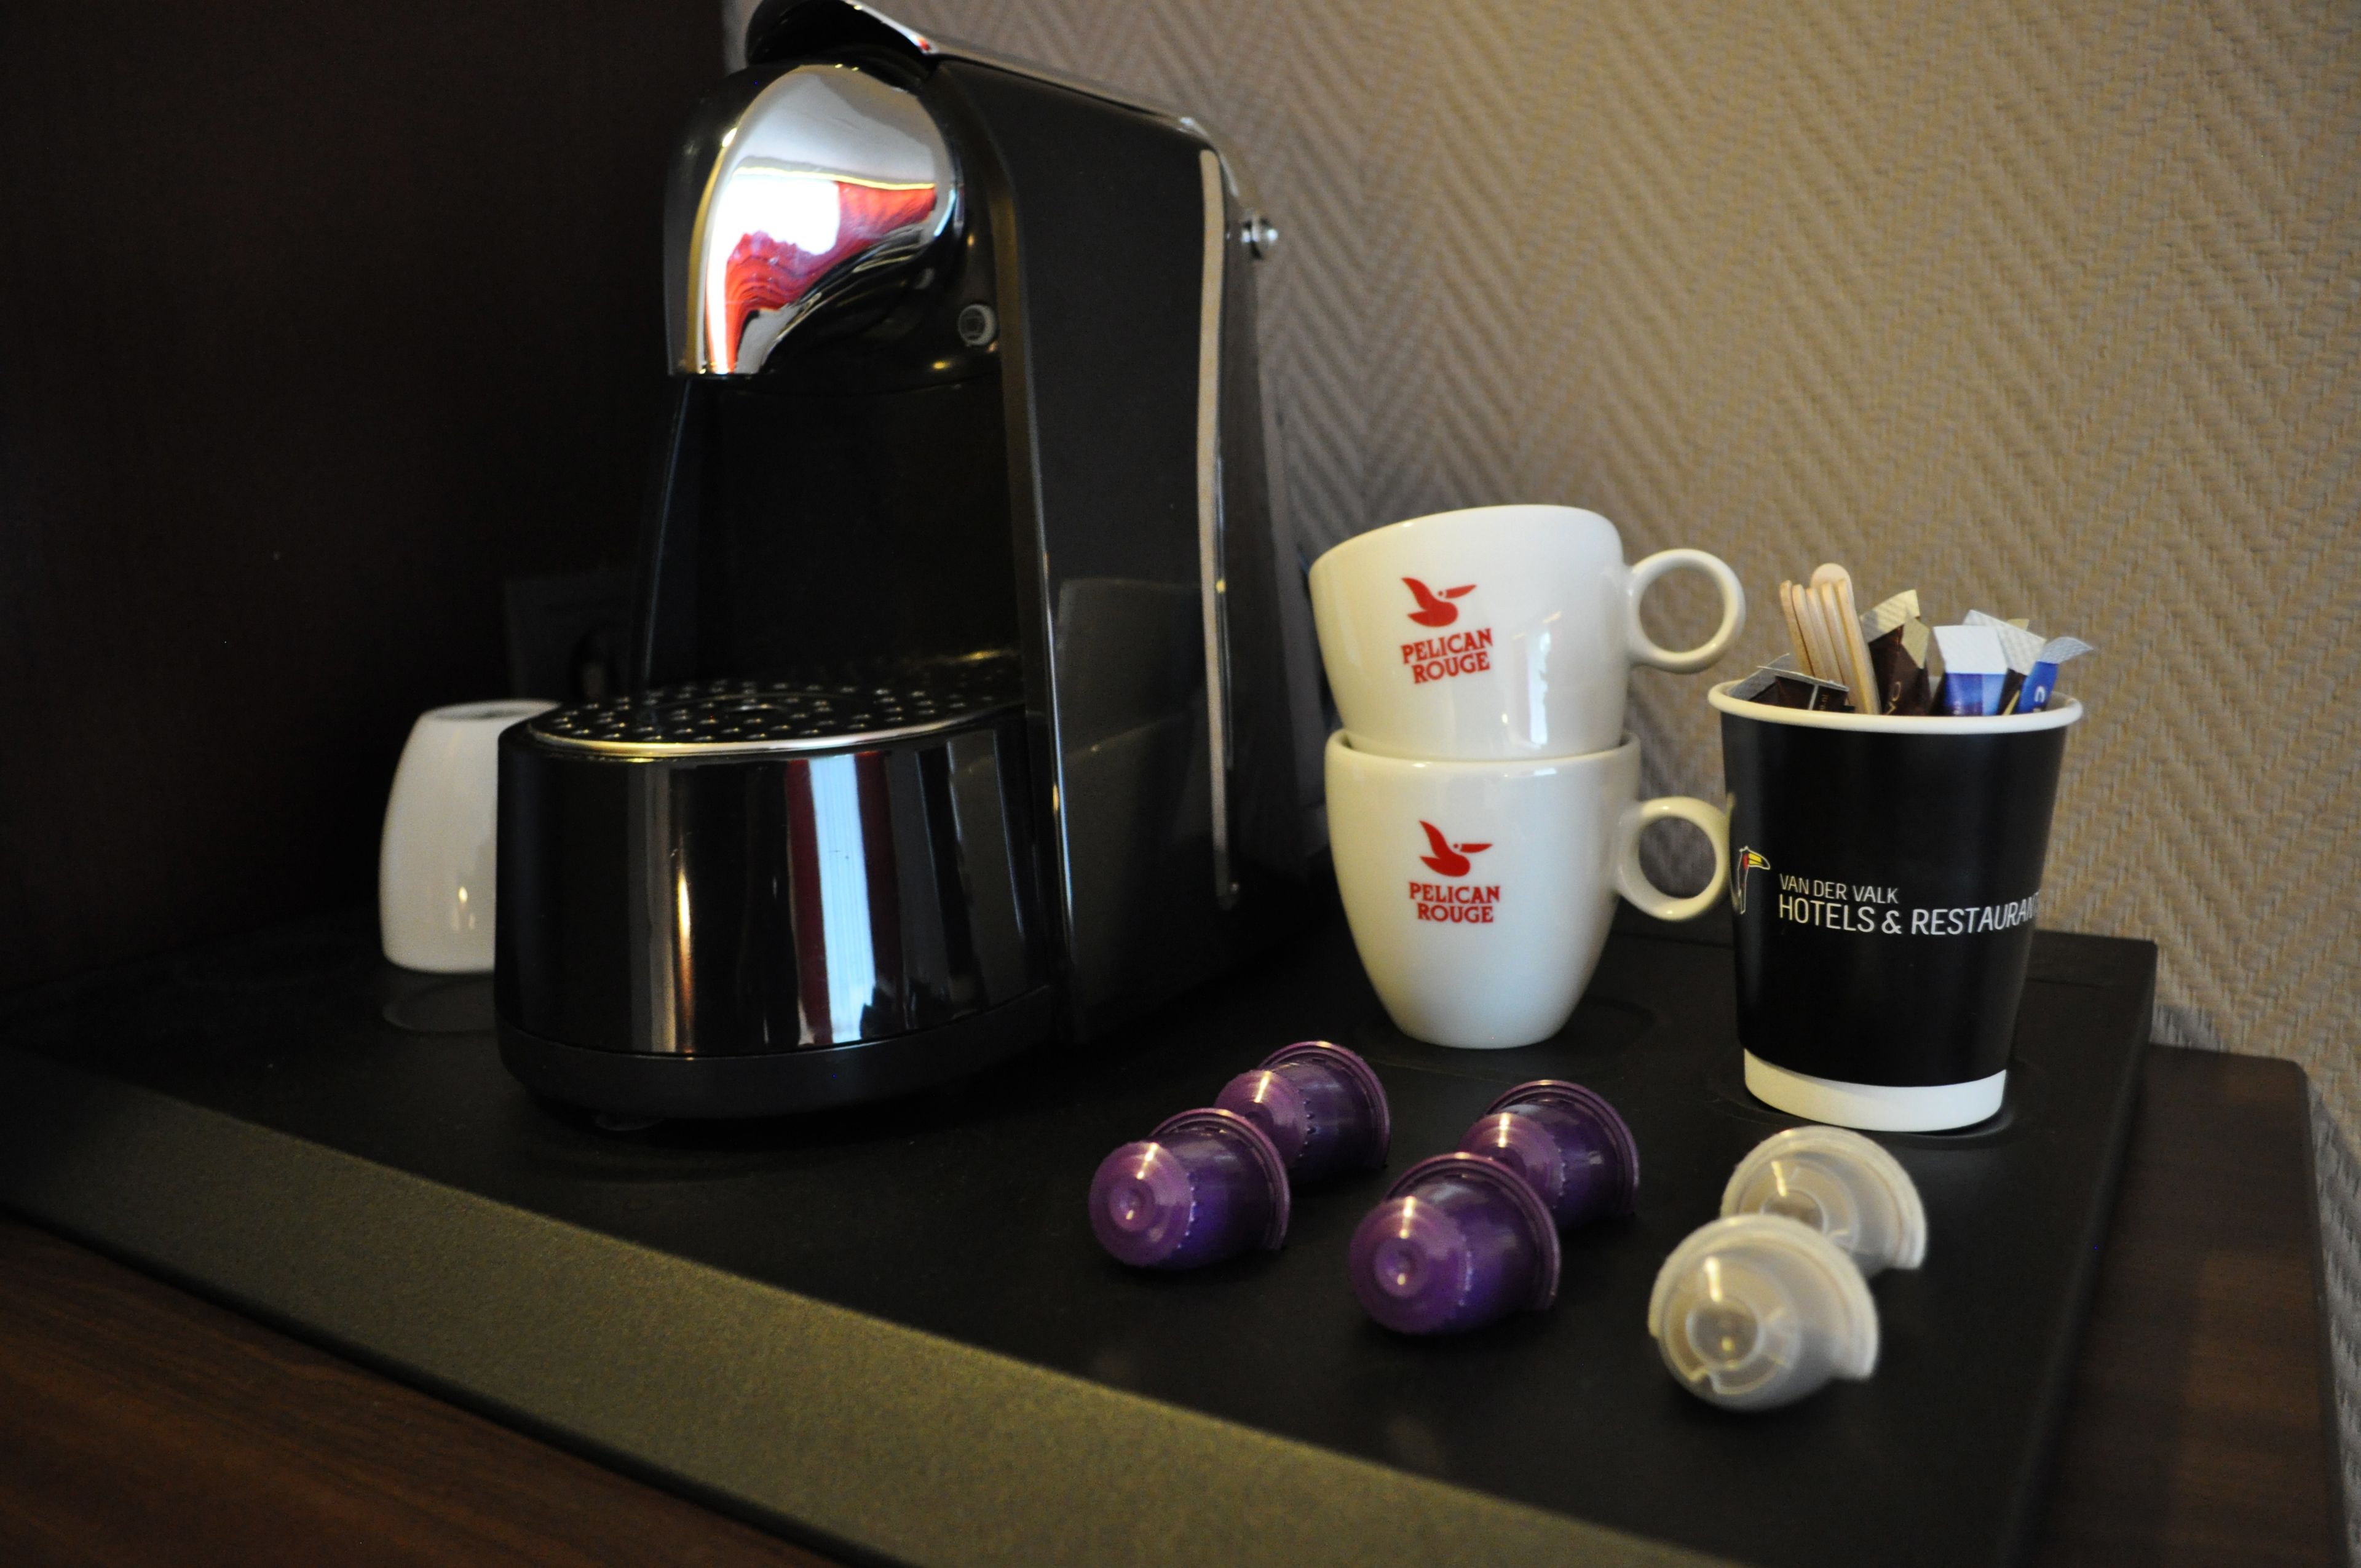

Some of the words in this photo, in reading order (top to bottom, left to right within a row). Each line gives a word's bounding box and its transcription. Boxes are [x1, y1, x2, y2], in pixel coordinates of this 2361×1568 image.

[1400, 628, 1493, 665] PELICAN
[1412, 651, 1490, 684] ROUGE
[1409, 881, 1500, 904] PELICAN
[1779, 873, 1809, 895] VAN
[1814, 880, 1848, 900] DER
[1853, 885, 1899, 905] VALK
[1417, 902, 1494, 924] ROUGE
[1779, 893, 1875, 933] HOTELS
[1881, 909, 1902, 935] &
